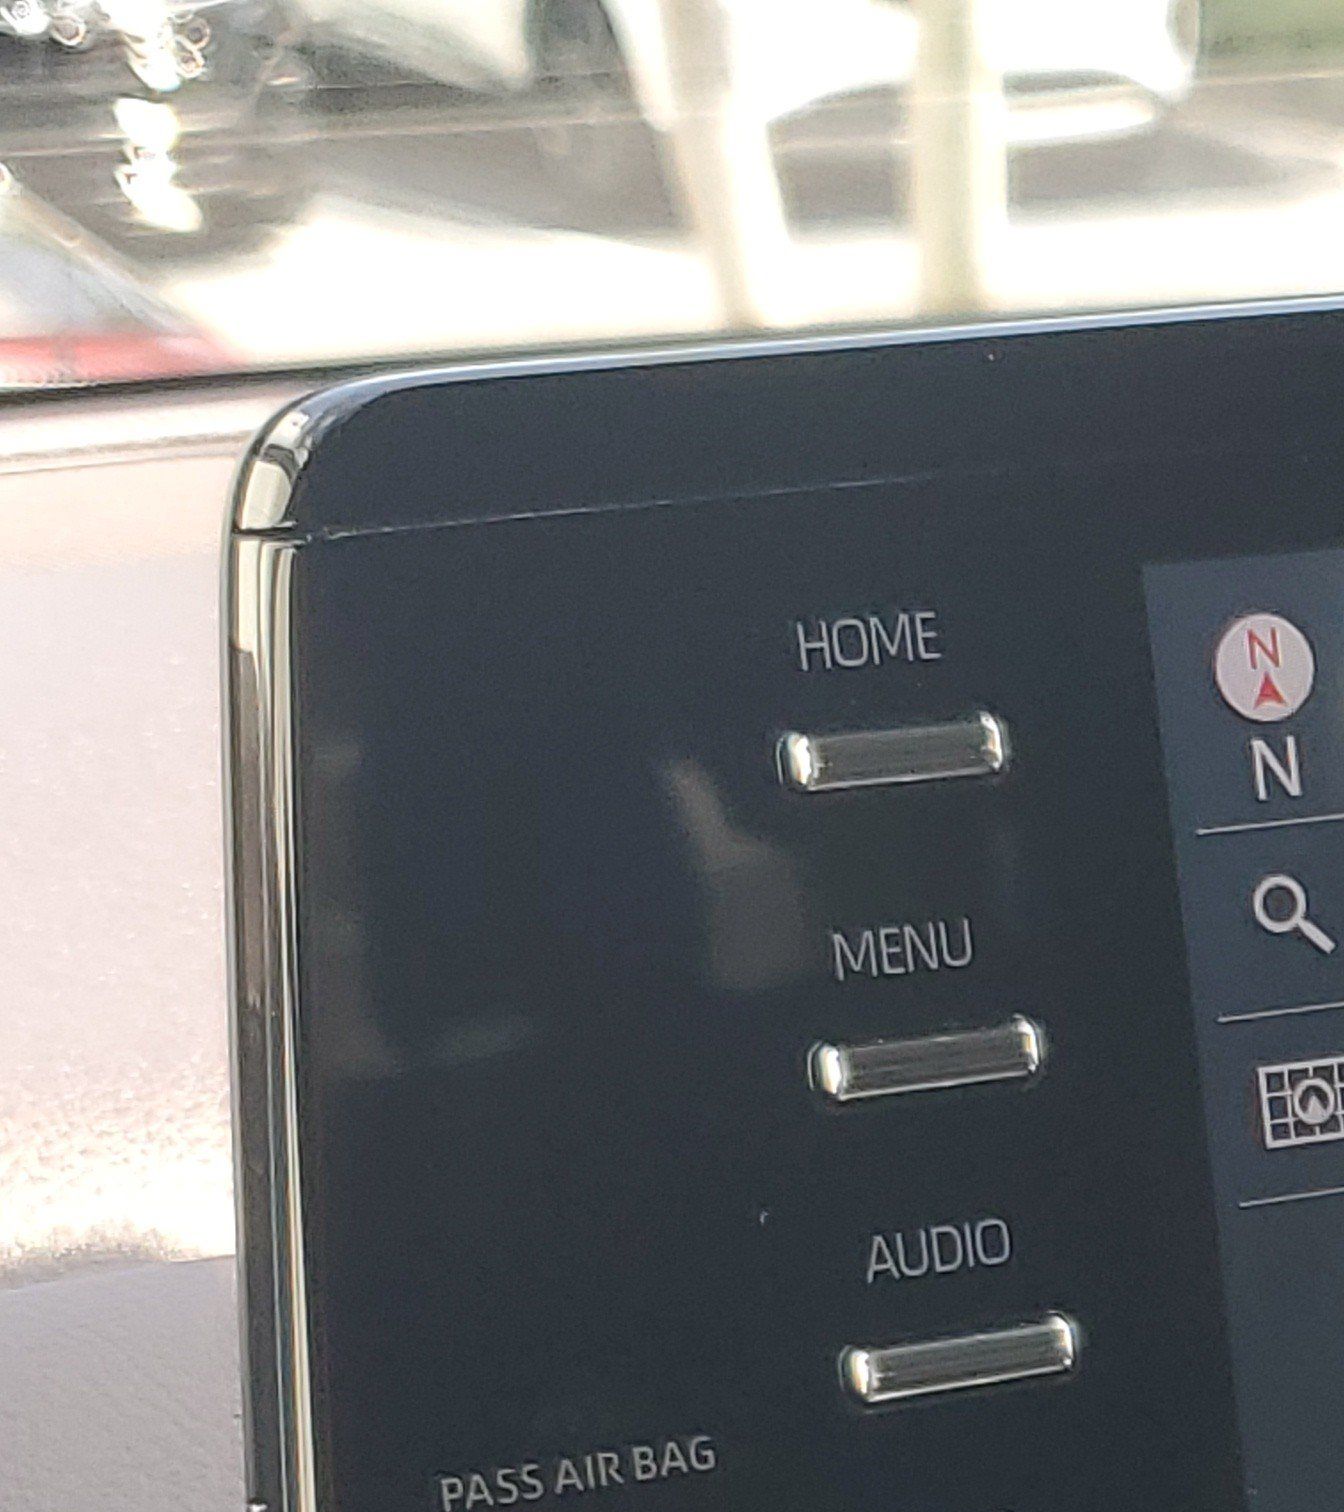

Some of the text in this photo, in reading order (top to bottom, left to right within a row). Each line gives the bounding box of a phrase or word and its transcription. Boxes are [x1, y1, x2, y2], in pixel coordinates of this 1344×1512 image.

[796, 612, 942, 671] HOME
[1247, 627, 1281, 670] N
[1251, 735, 1302, 801] N
[833, 919, 972, 981] MENU
[866, 1218, 1012, 1283] AUDIO
[440, 1436, 717, 1512] PASS AIR BAG
